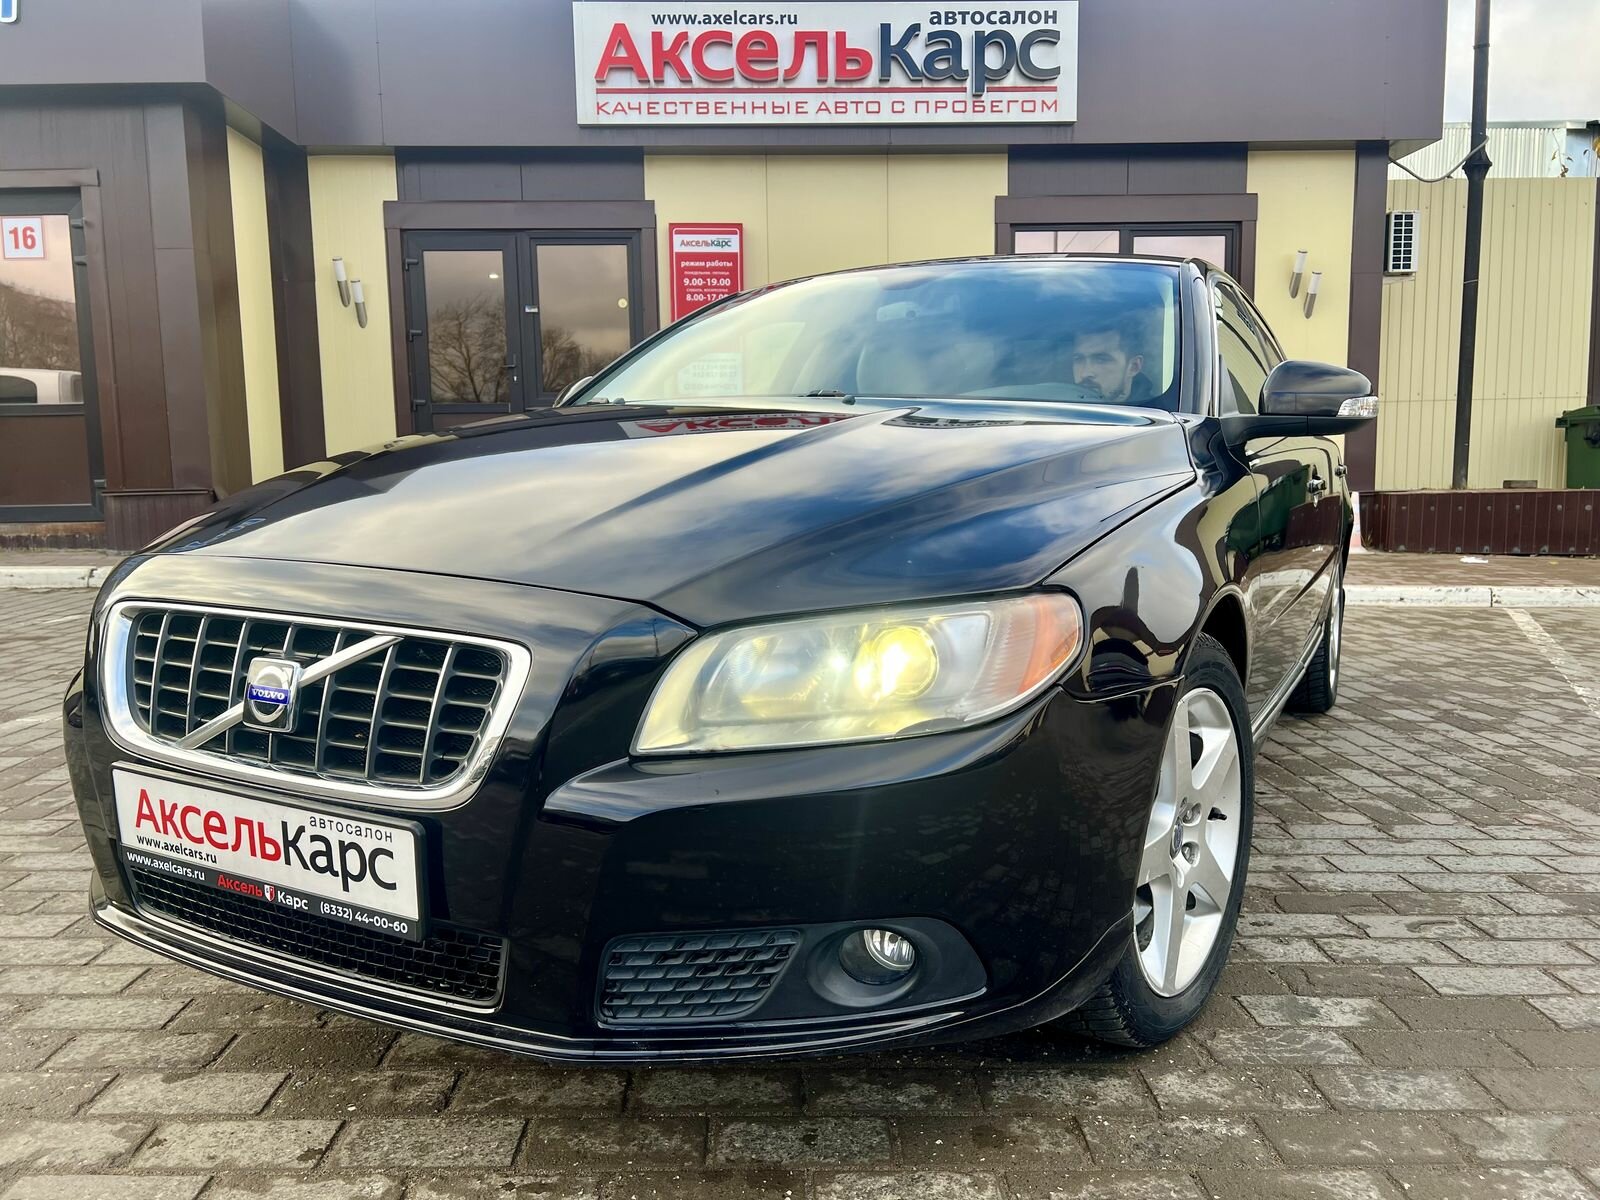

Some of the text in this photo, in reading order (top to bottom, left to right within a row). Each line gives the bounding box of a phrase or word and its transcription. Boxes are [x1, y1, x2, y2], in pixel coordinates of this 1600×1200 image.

[651, 10, 798, 26] www.axelcars.ru
[929, 8, 1058, 26] автосалон
[595, 22, 1062, 97] АксельКарс
[596, 98, 1059, 116] КАЧЕСТВЕННЫЕ АВТО С ПРОБЕГОМ
[8, 225, 37, 250] 16
[706, 260, 732, 268] работы
[683, 278, 731, 286] 9.00-19.00
[251, 688, 286, 700] VOLVO
[135, 788, 397, 893] АксельКарс
[309, 815, 393, 844] автосалон
[136, 833, 218, 864] www.axelcars.ru
[126, 851, 206, 881] www.axelcars.ru
[217, 874, 309, 911] Аксель Карс
[320, 900, 409, 935] (8332) 44-00-60
